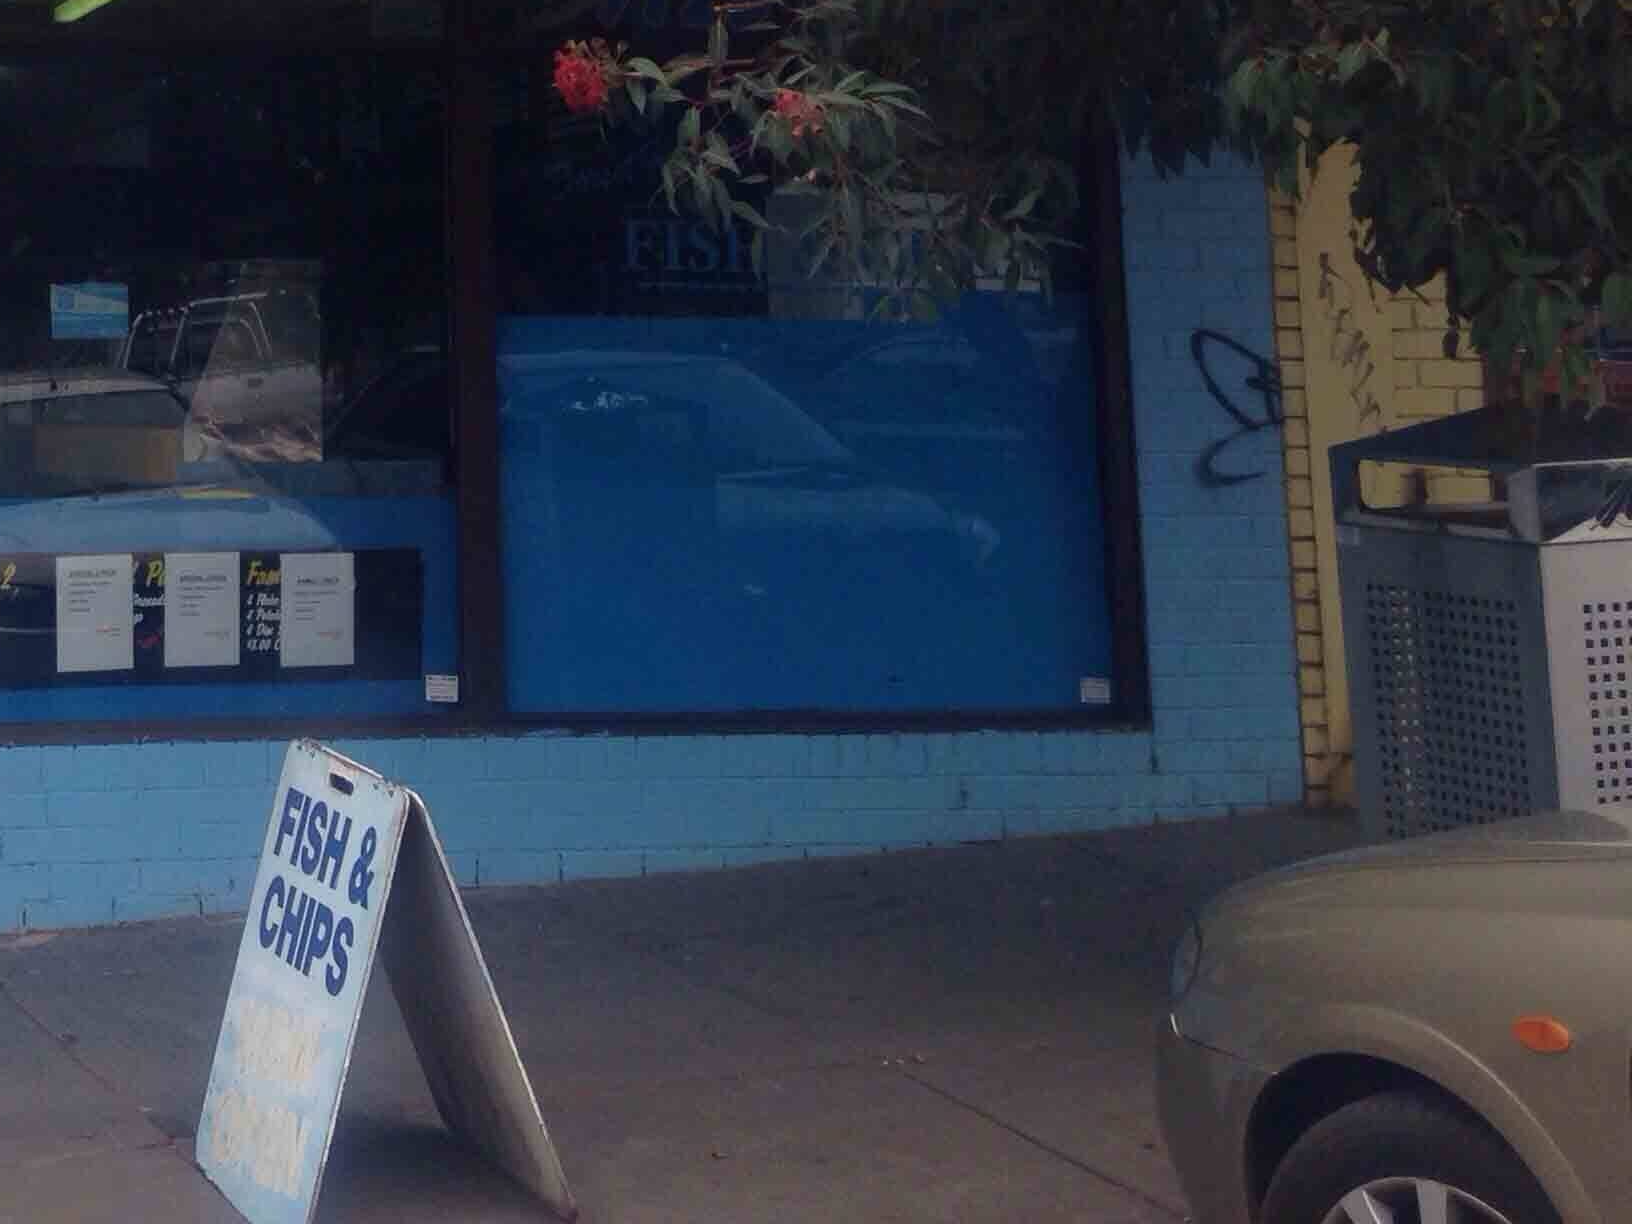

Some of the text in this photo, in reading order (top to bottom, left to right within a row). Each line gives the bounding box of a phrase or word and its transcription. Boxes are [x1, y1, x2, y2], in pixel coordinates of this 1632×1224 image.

[273, 786, 377, 910] FISH &
[258, 875, 355, 997] CHIPS
